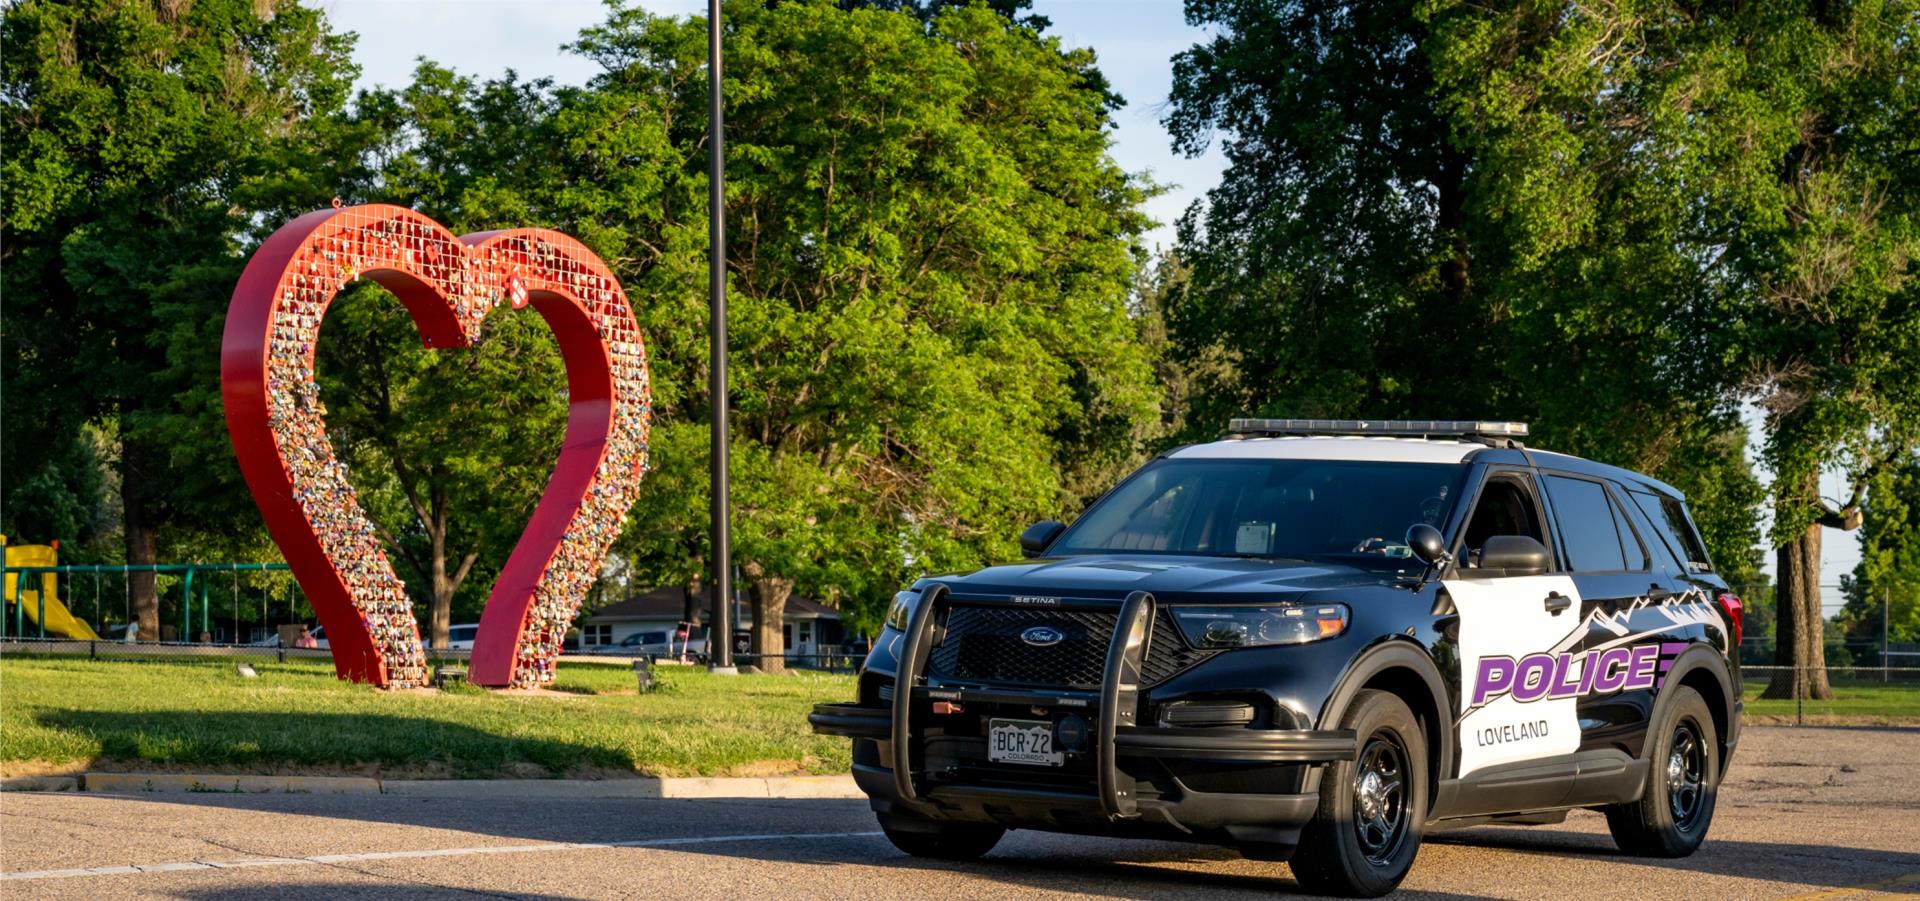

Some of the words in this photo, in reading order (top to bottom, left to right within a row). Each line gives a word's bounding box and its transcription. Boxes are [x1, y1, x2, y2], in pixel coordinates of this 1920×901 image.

[1471, 645, 1660, 707] POLICE
[1477, 719, 1549, 747] LOVELAND
[1008, 753, 1045, 761] COLORADO
